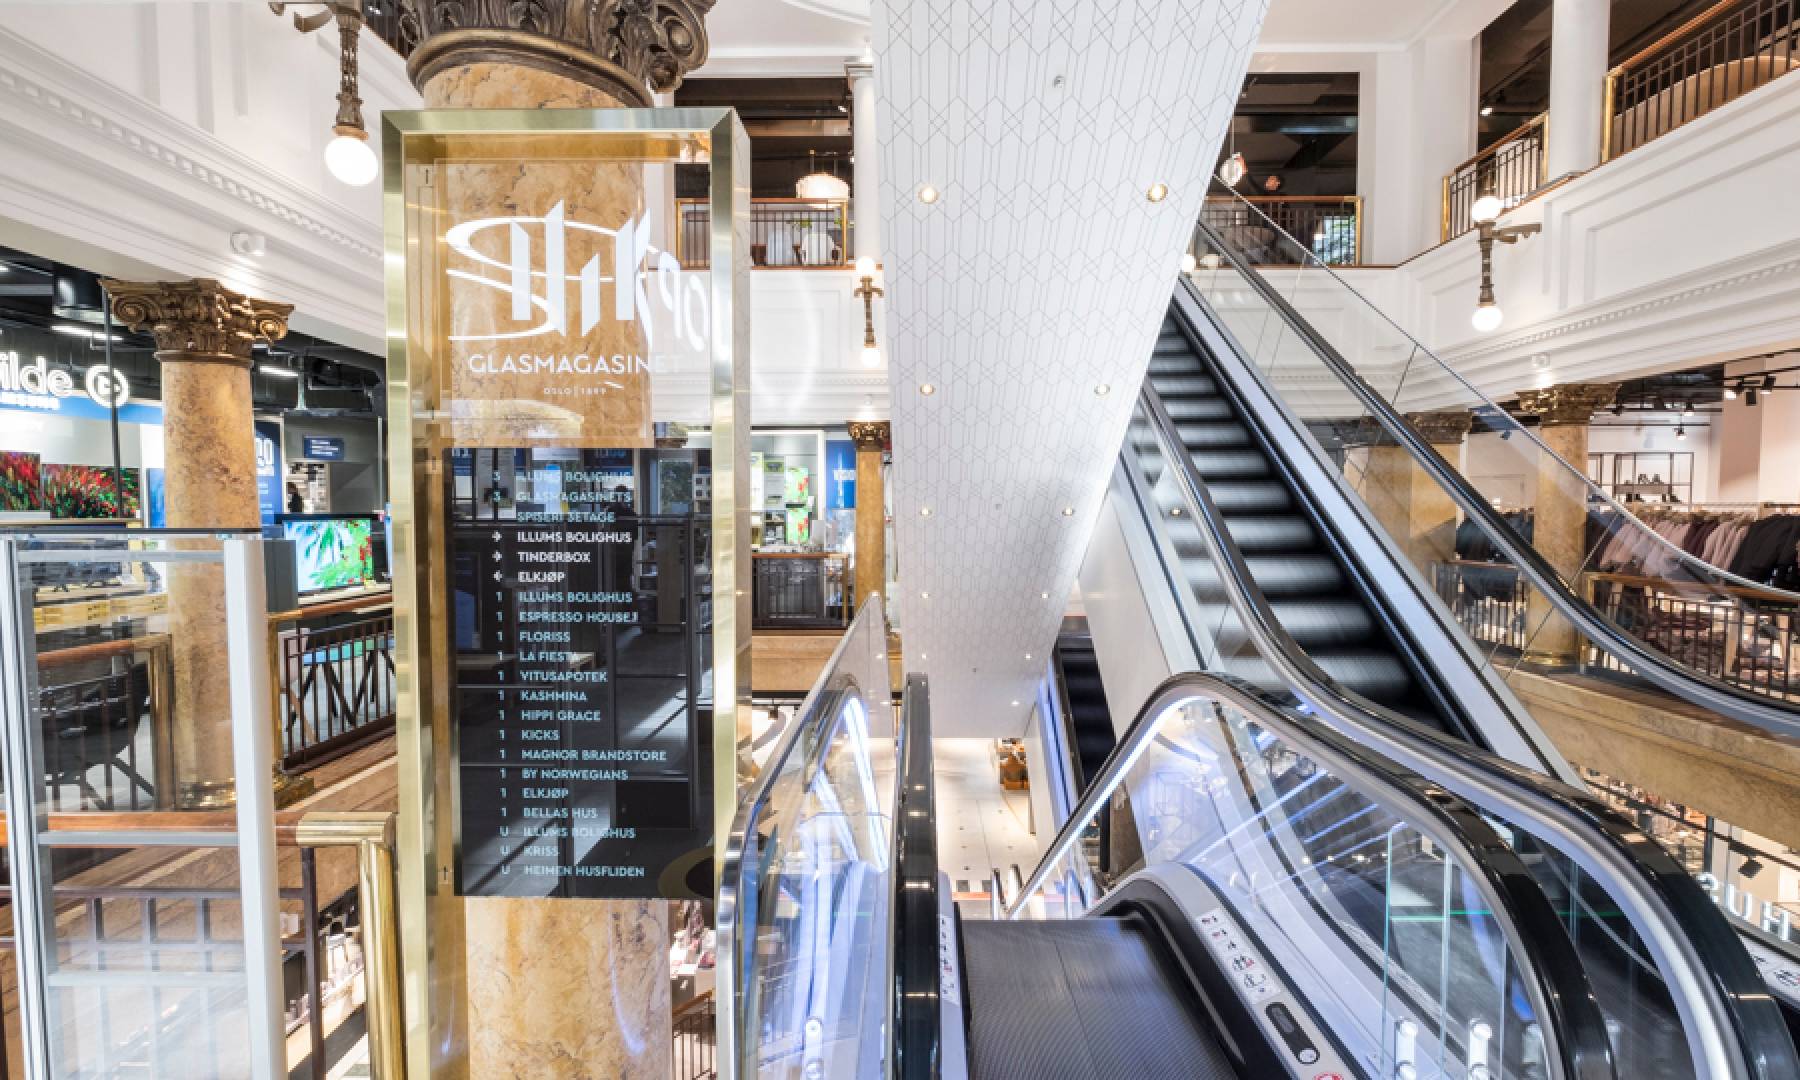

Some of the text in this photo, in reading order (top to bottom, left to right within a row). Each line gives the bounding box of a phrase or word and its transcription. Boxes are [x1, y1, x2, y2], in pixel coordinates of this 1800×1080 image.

[469, 354, 686, 374] GLASMAGASINET
[565, 472, 632, 482] BOLIGHUS
[517, 532, 632, 542] ILLUMS BOLIGHUS
[517, 552, 591, 562] TINDERBOX
[518, 572, 566, 582] ELKJØP
[519, 592, 562, 602] ILLUMS
[567, 592, 632, 602] BOLIGHUS
[519, 612, 582, 622] ESPRESSO
[519, 632, 570, 642] FLORISS
[520, 652, 534, 662] LA
[520, 671, 608, 682] VITUSAPOTEK
[521, 711, 553, 721] HIPPI
[557, 711, 601, 721] GRACE
[521, 730, 560, 740] KICKS
[522, 750, 578, 760] MAGNOR
[582, 750, 667, 760] BRANDSTORE
[522, 770, 537, 780] BY
[541, 770, 629, 780] NORWEGIANS
[523, 788, 569, 798] ELKJØP
[523, 808, 568, 818] BELLAS
[572, 808, 598, 818] HUS
[500, 827, 636, 838] U ILLUMS BOLIGHUS
[524, 847, 559, 857] KRISS
[525, 866, 571, 876] HEIMEN
[576, 866, 645, 877] HUSFLIDEN
